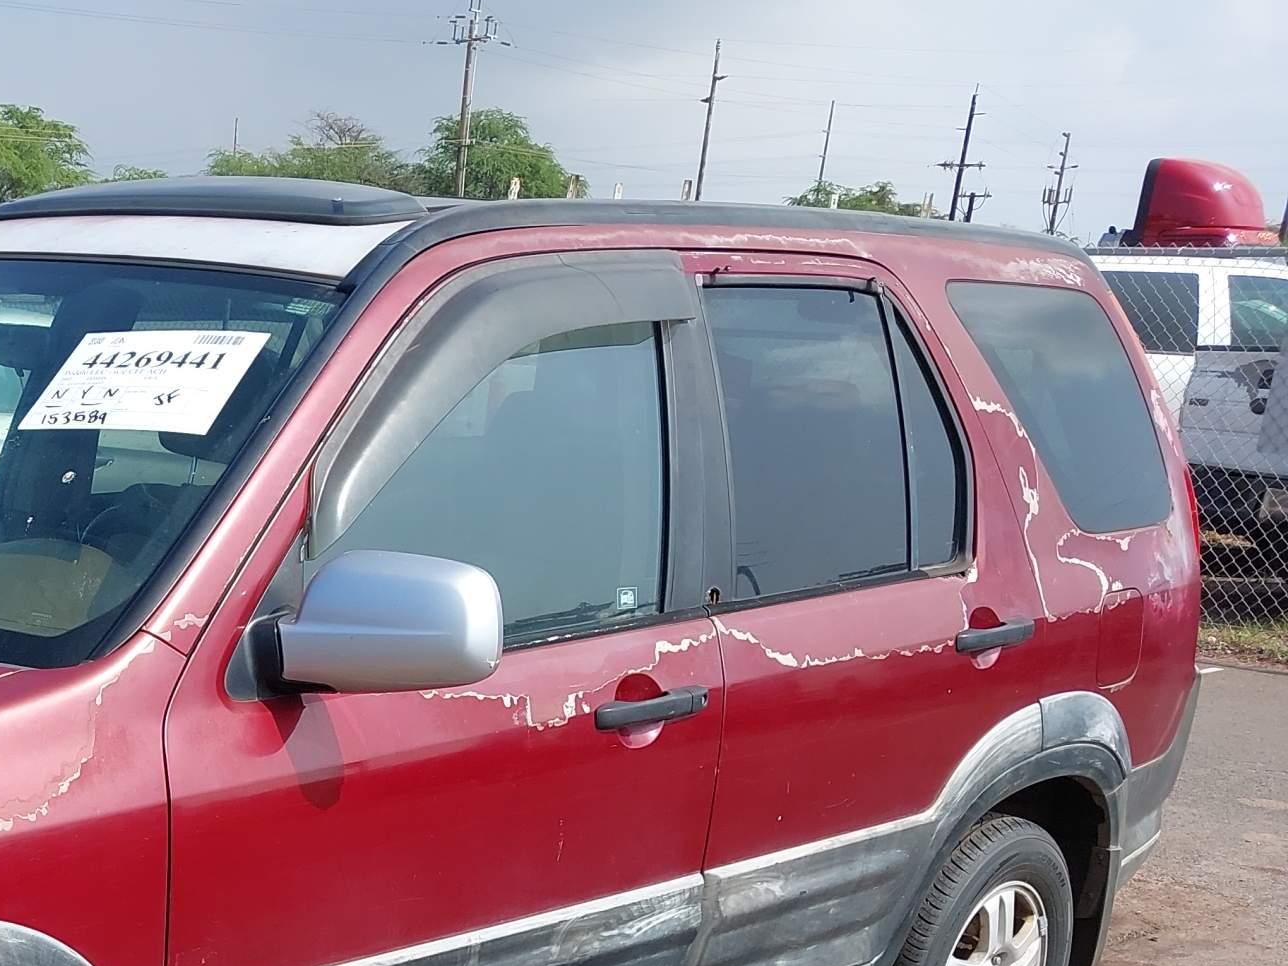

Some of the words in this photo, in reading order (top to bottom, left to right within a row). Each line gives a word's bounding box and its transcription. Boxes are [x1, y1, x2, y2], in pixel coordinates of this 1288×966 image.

[82, 350, 227, 370] 44269441
[51, 389, 70, 400] N
[103, 388, 120, 399] N
